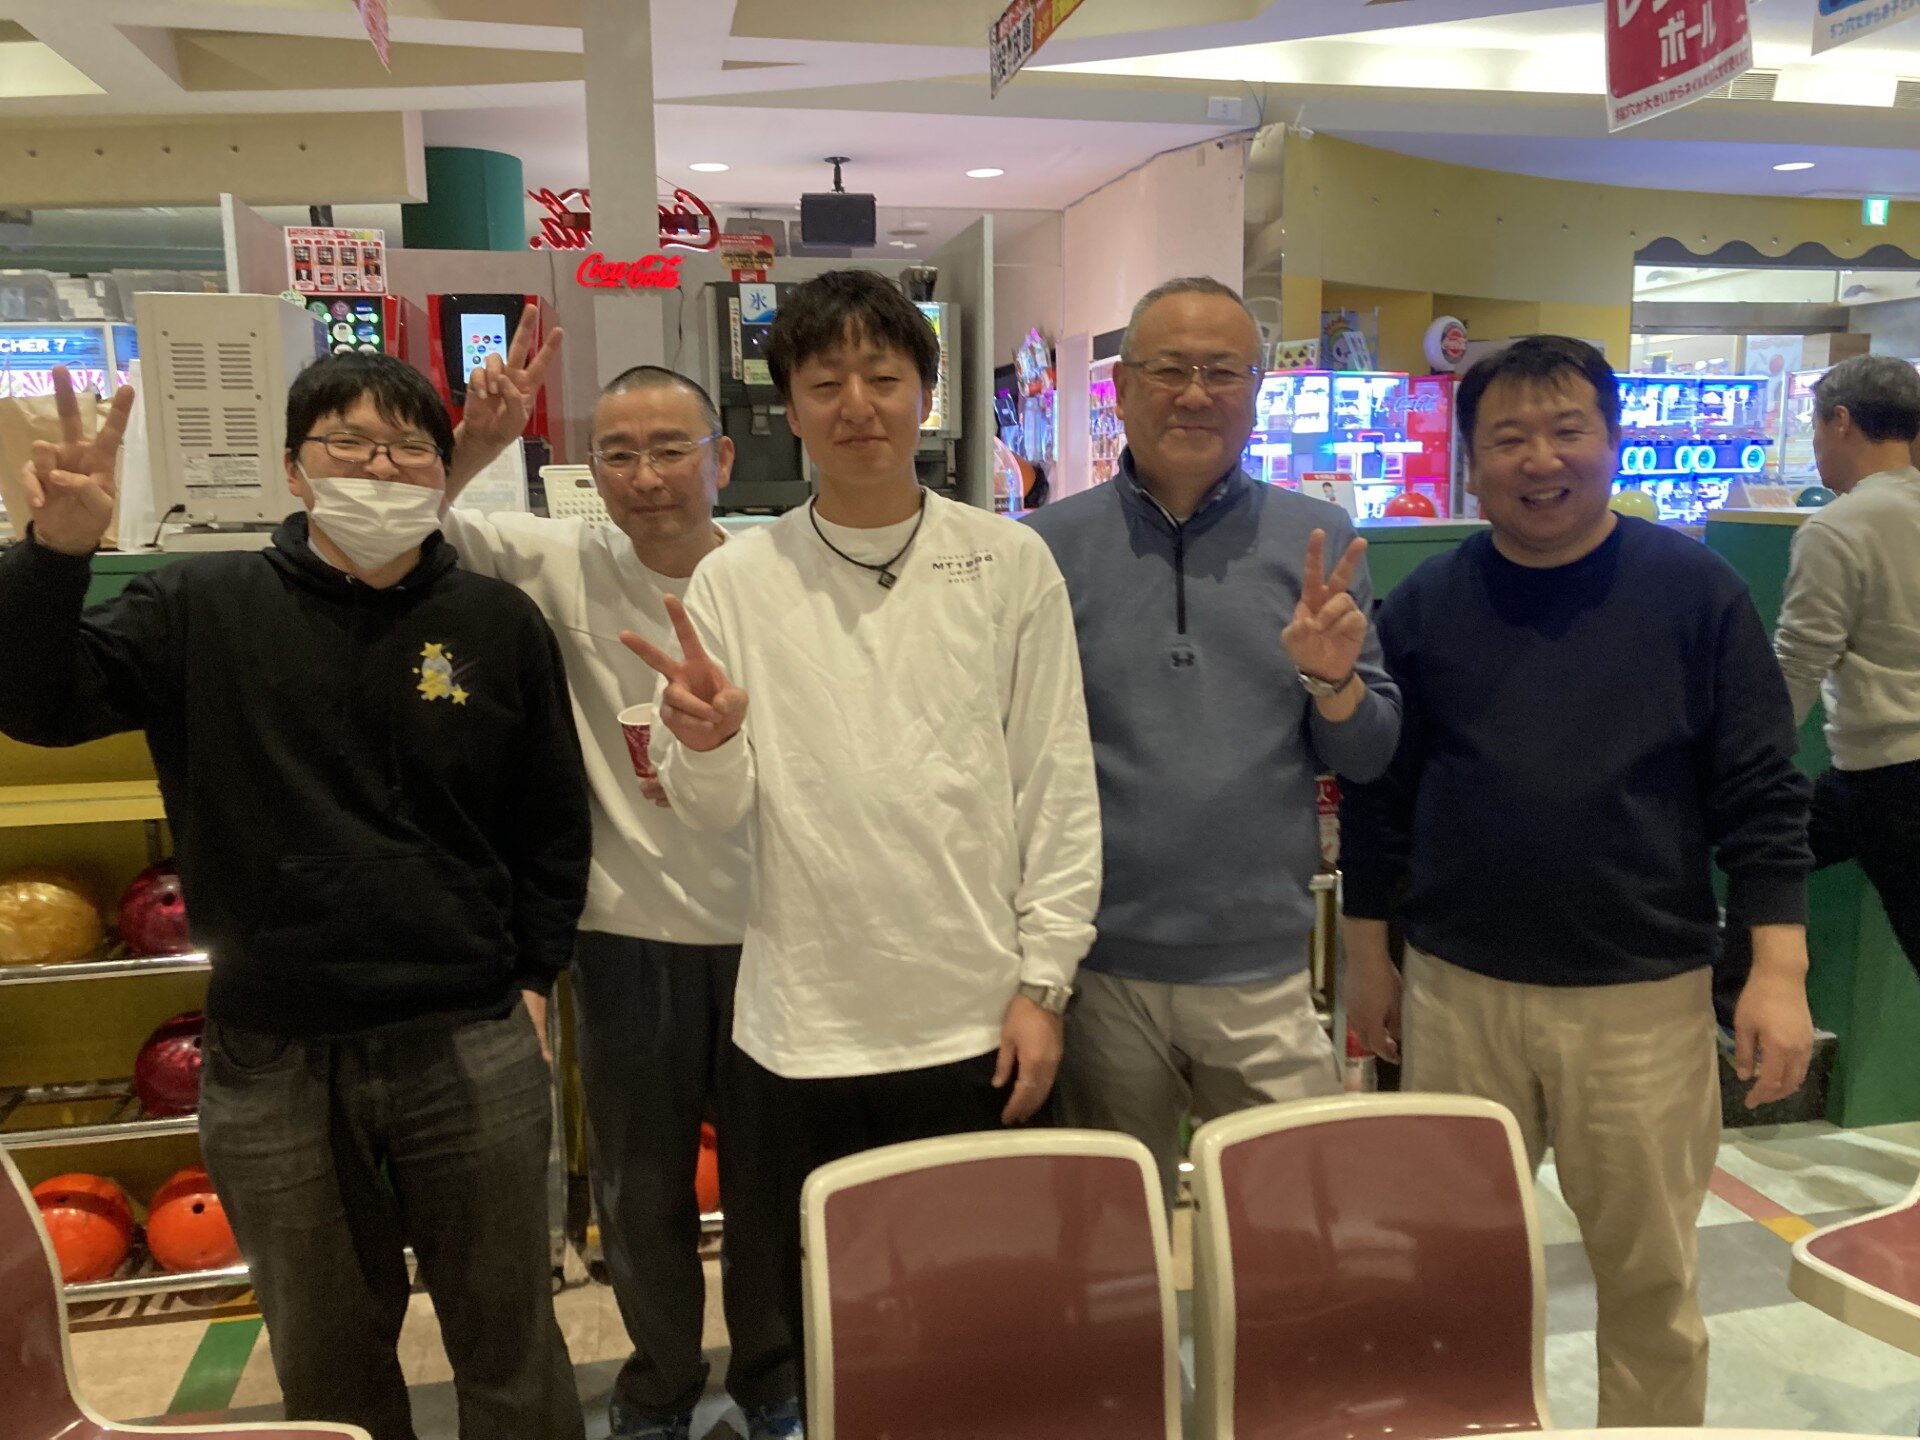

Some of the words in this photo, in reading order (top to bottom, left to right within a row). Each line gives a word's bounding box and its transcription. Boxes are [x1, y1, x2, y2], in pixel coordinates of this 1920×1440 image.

[1658, 1, 1716, 68] ボール
[576, 252, 685, 288] Coca-Cola
[750, 293, 767, 310] 氷
[53, 338, 68, 353] 7
